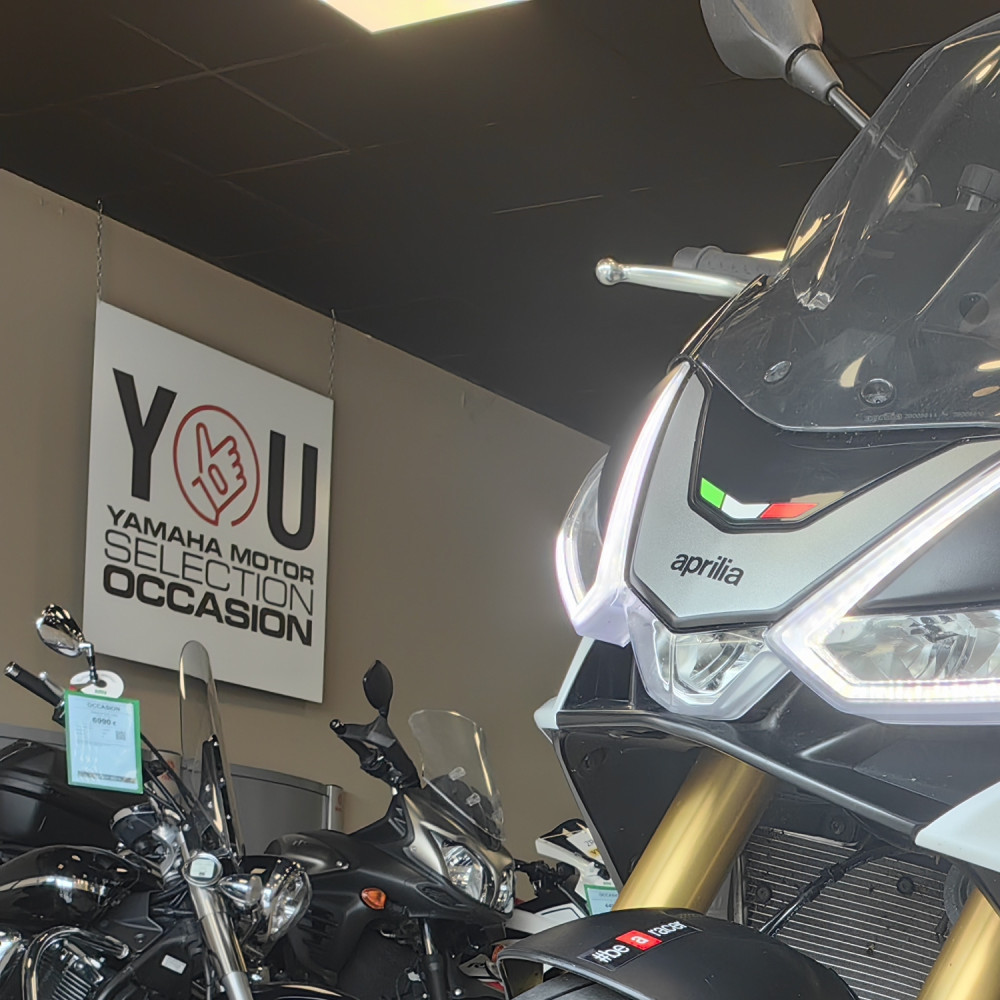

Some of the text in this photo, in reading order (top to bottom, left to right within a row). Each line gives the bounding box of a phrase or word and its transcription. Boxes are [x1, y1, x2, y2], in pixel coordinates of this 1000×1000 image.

[104, 529, 313, 616] SELECTION
[107, 504, 314, 585] YAMAHA MOTOR
[670, 553, 744, 586] aprilia
[103, 564, 312, 647] OCCASION
[592, 920, 688, 963] #be a racer
